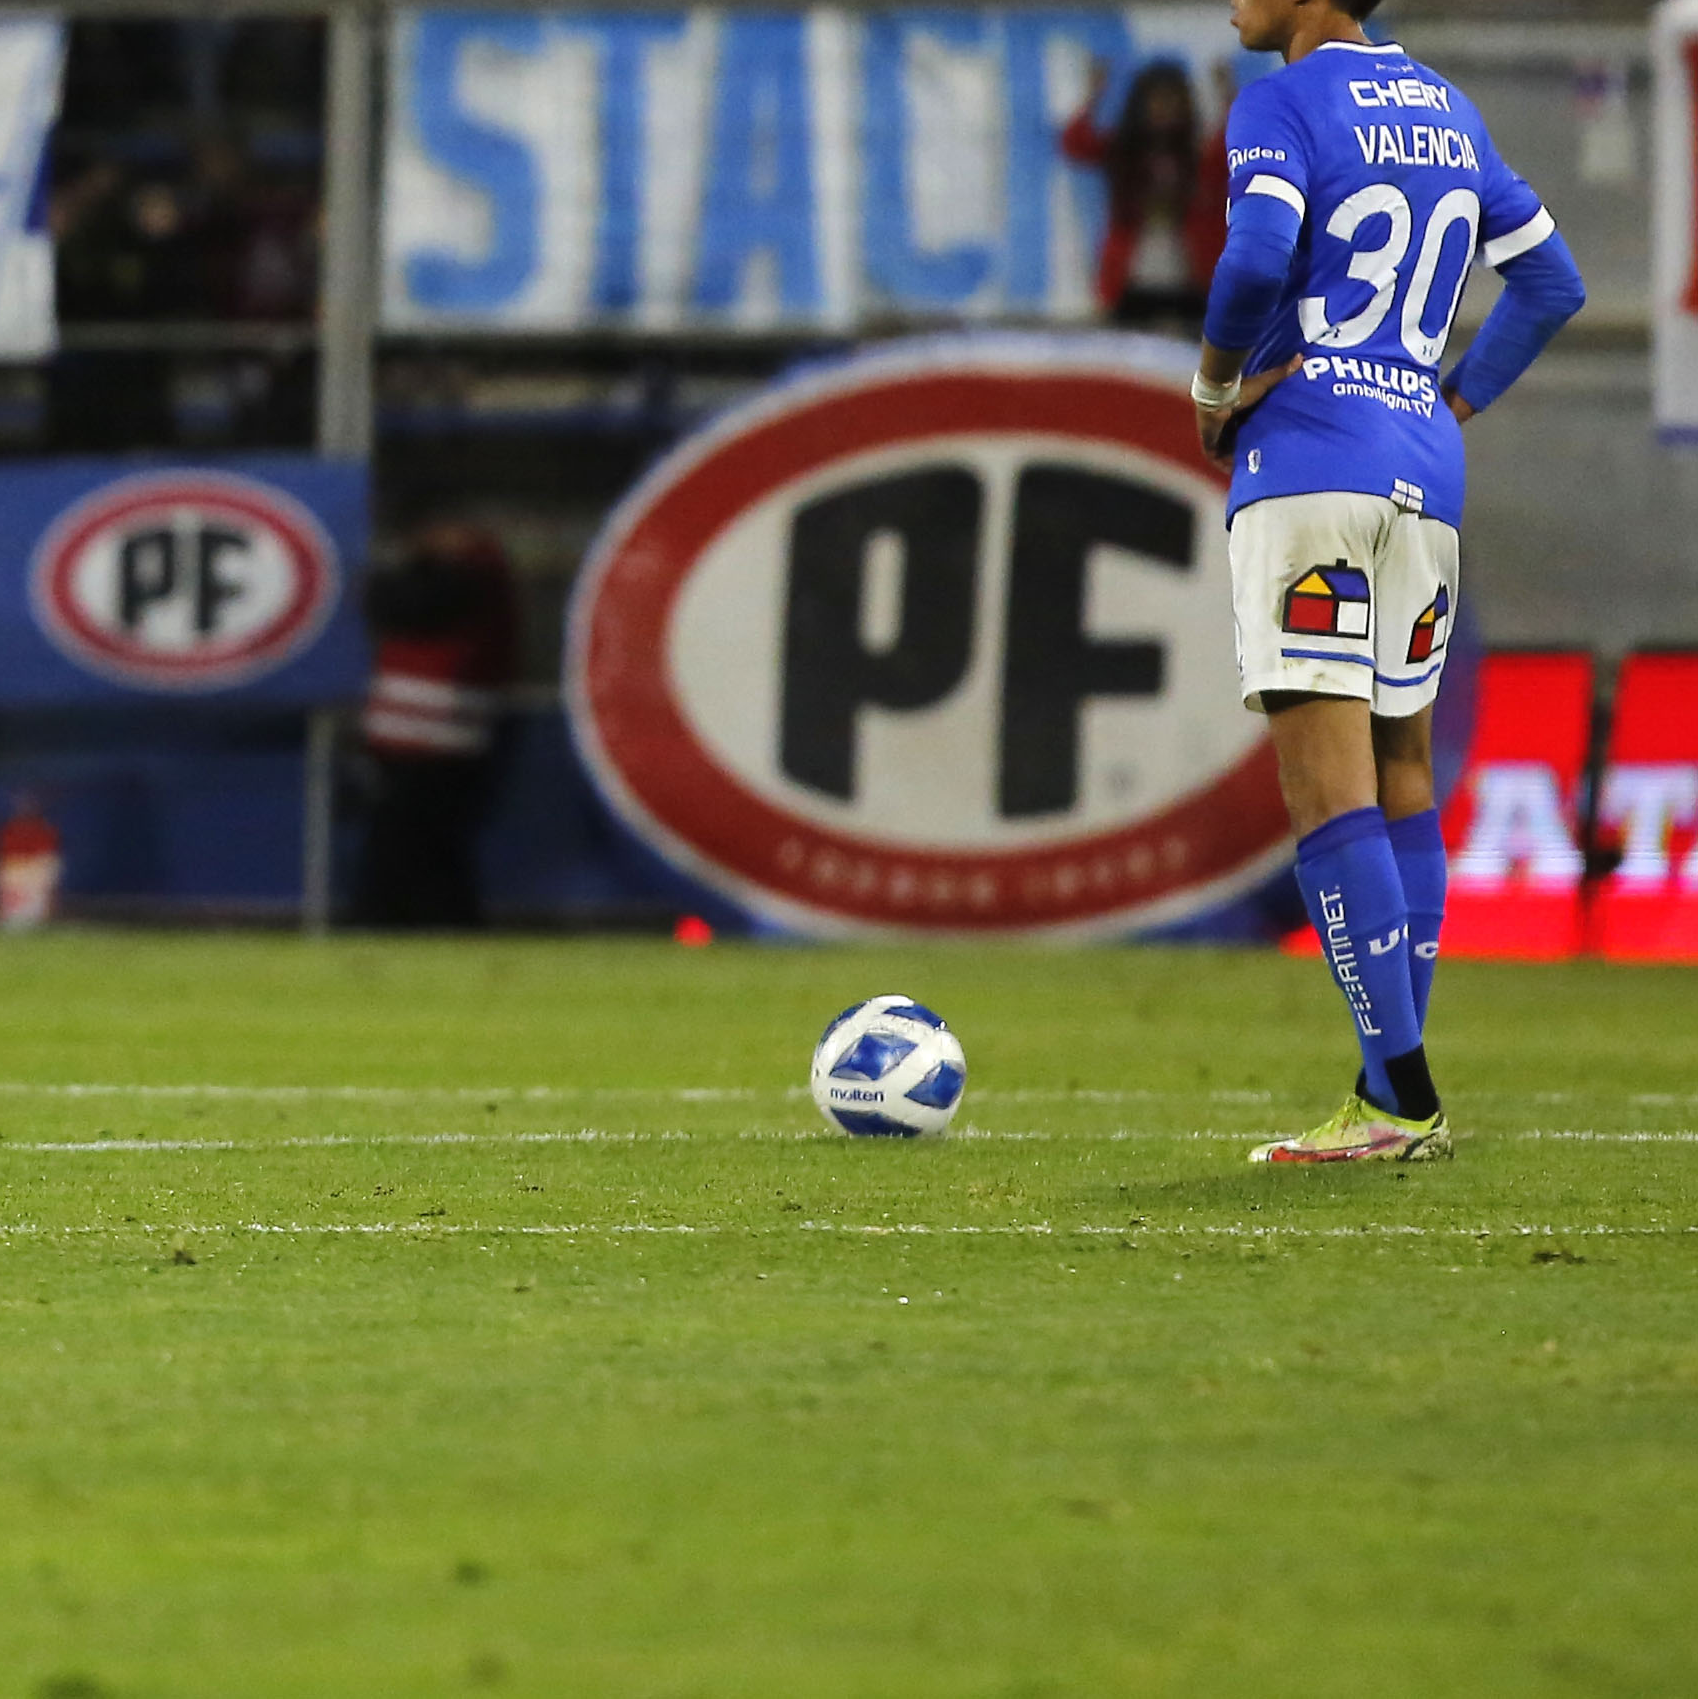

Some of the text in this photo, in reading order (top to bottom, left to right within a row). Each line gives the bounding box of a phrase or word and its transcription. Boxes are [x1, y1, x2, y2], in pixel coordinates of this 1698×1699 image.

[1348, 78, 1452, 112] CHERY
[1353, 124, 1479, 172] VALENCIA
[1297, 183, 1480, 366] 30
[1303, 355, 1437, 403] PHILIPS
[116, 528, 249, 635] PF
[778, 460, 1195, 820] PF
[1449, 762, 1698, 894] AT
[829, 1086, 884, 1103] molten
